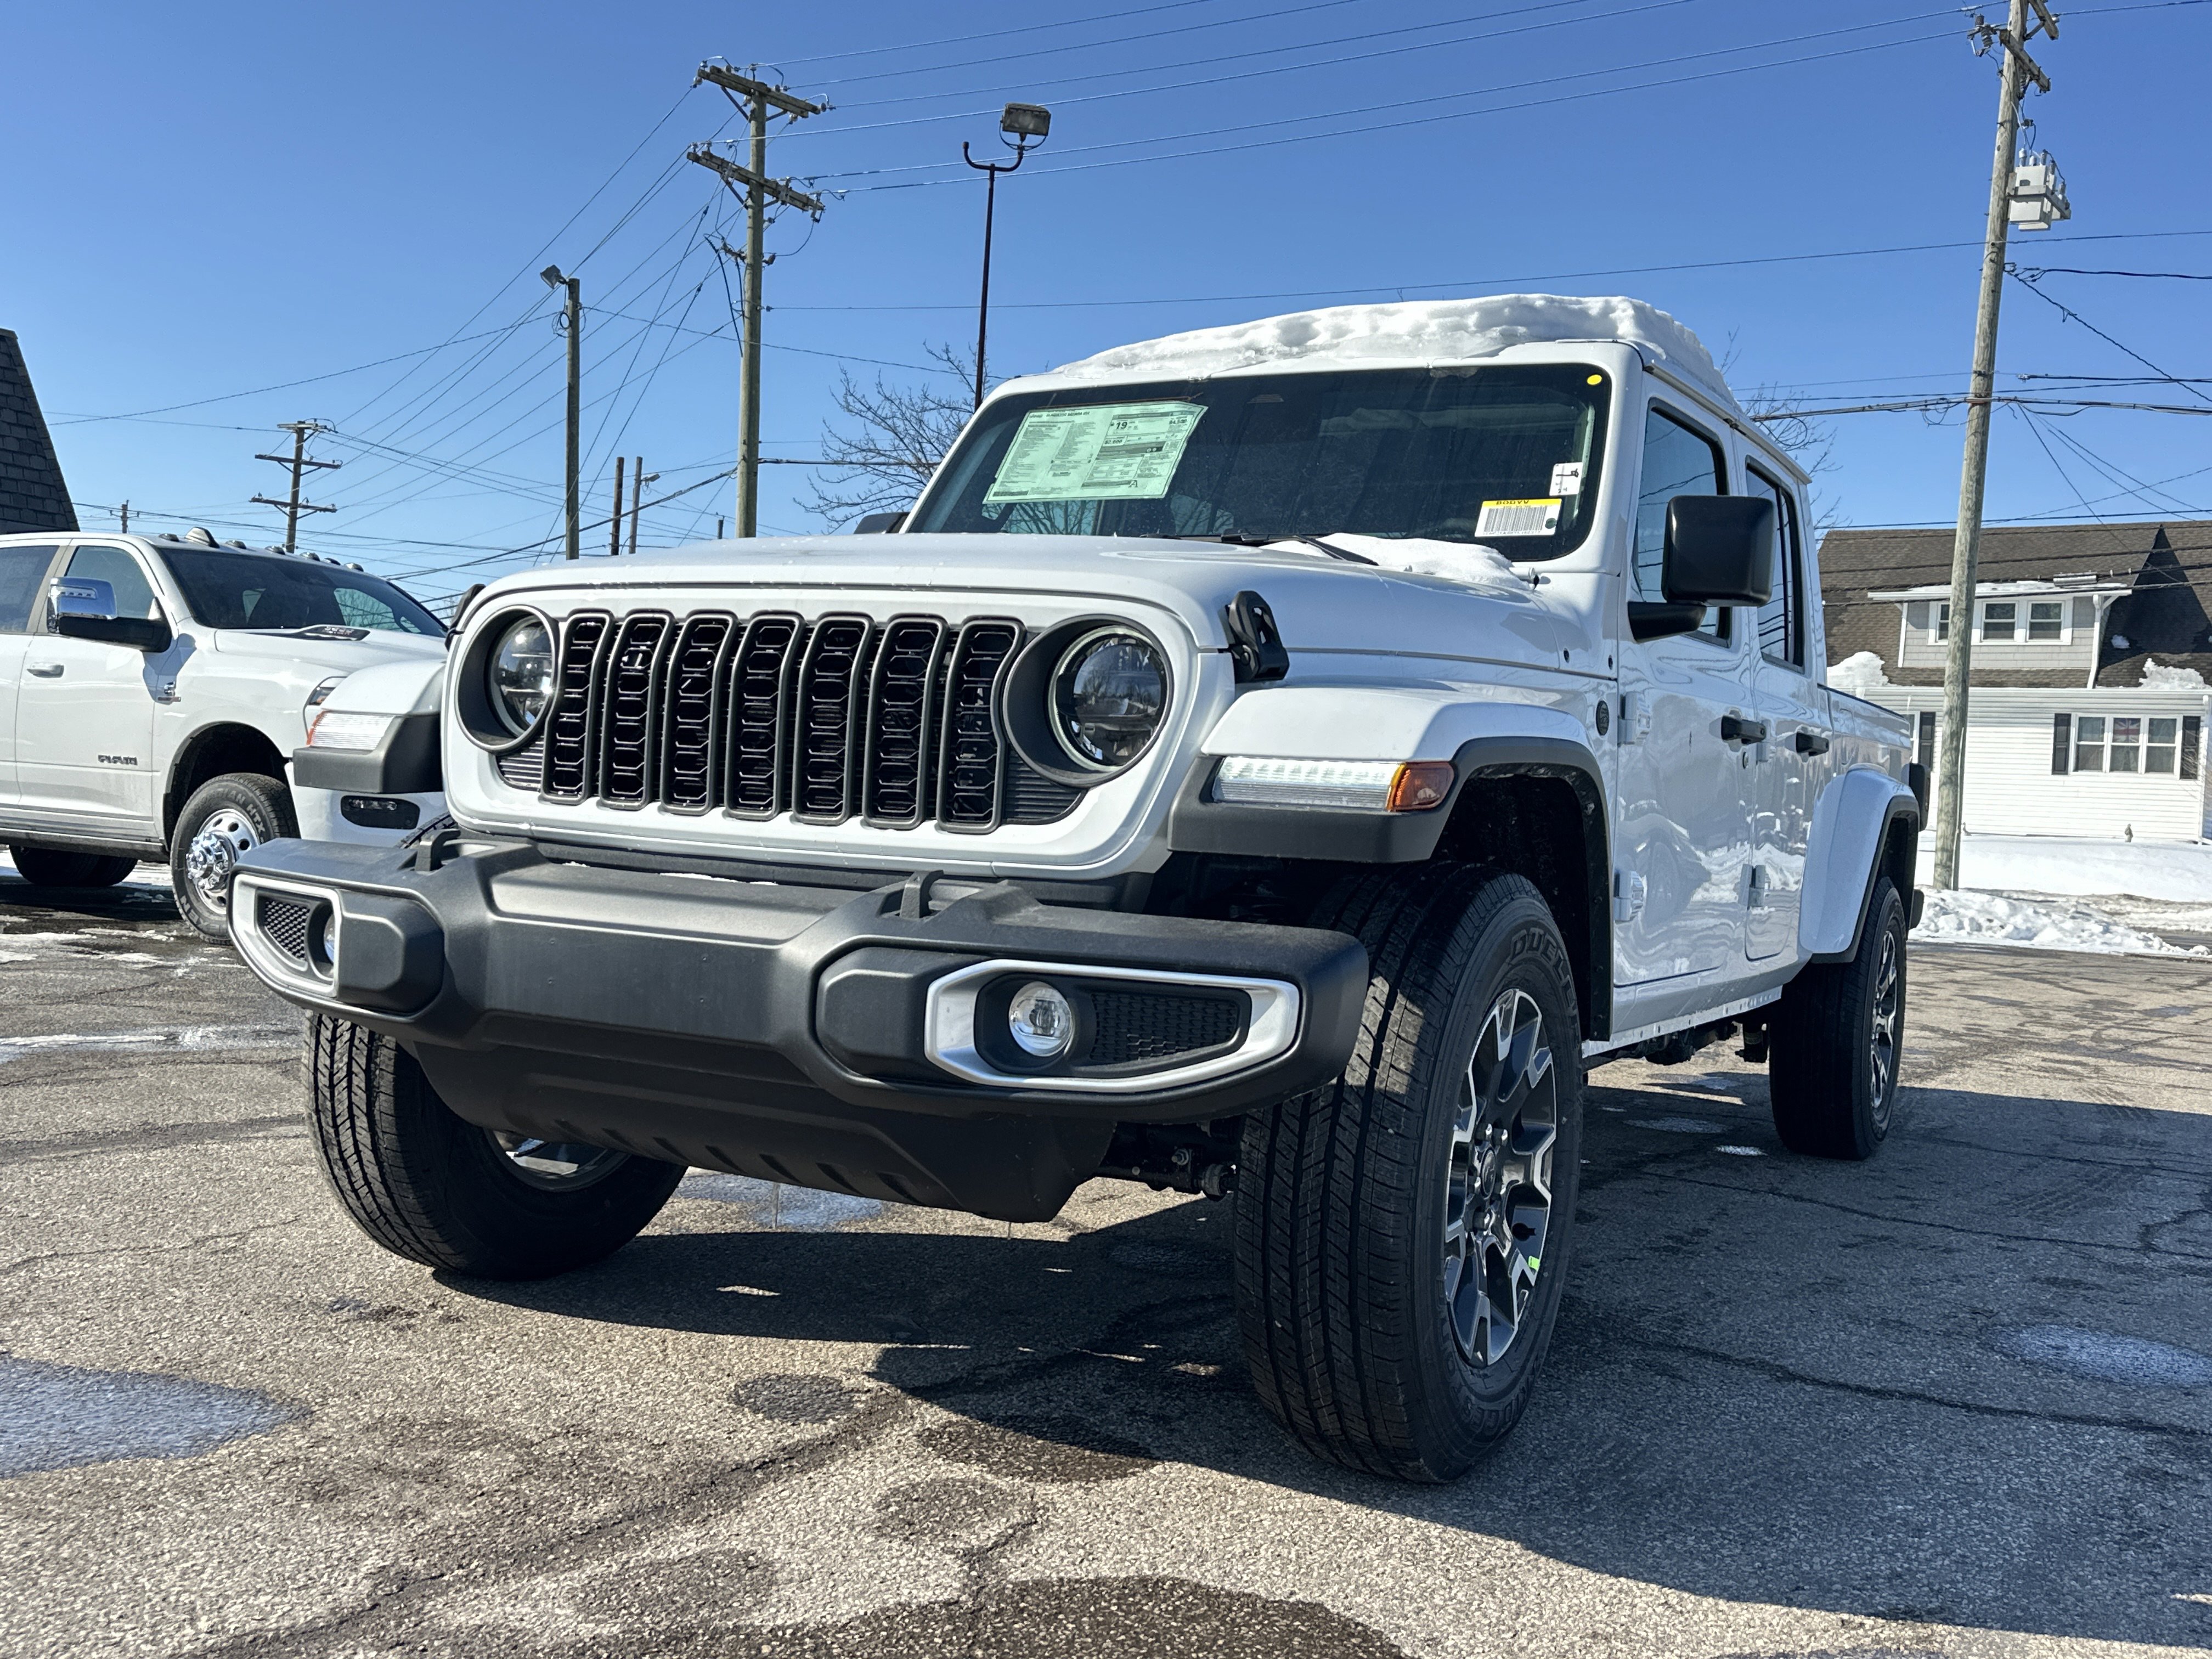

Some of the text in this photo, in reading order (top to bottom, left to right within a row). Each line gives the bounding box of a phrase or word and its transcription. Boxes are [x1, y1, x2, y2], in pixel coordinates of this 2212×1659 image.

[1116, 421, 1128, 430] 19
[98, 754, 138, 766] RAM
[246, 804, 266, 834] HTX
[1509, 927, 1580, 1045] DUELER
